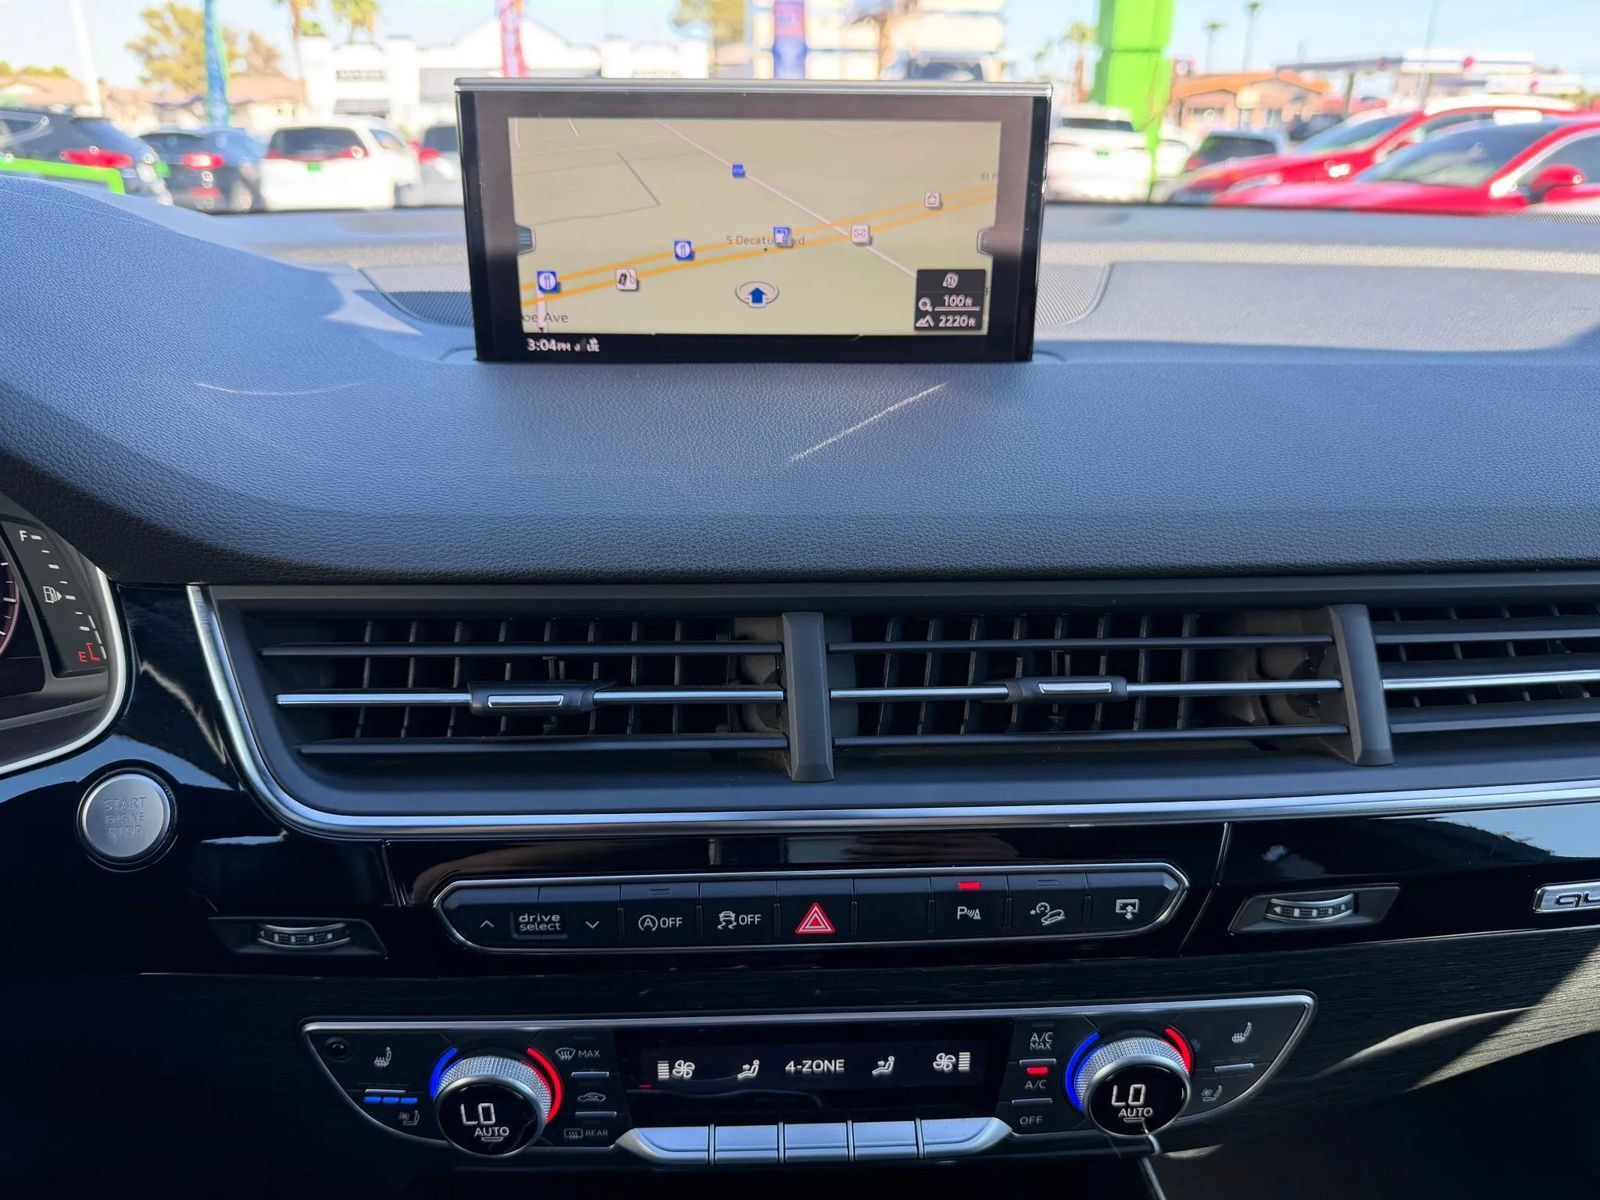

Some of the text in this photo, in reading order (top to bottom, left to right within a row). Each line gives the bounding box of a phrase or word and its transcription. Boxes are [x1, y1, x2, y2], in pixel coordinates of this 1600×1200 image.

[726, 235, 733, 245] S
[544, 312, 569, 323] Ave
[19, 530, 28, 542] F
[78, 650, 88, 663] E
[103, 796, 147, 811] START
[106, 824, 144, 840] STOP
[518, 912, 561, 923] drive
[659, 916, 683, 929] OFF
[738, 914, 762, 926] OFF
[519, 921, 562, 932] select
[1029, 1031, 1054, 1043] A/C
[1029, 1042, 1052, 1050] MAX
[578, 1049, 601, 1058] MAX
[784, 1058, 846, 1074] 4-ZONE
[1024, 1079, 1047, 1090] A/C
[1111, 1083, 1146, 1106] LO
[460, 1102, 496, 1126] LO
[1118, 1106, 1153, 1118] AUTO
[1018, 1115, 1043, 1126] OFF
[473, 1126, 510, 1138] AUTO
[584, 1129, 609, 1137] REAR
